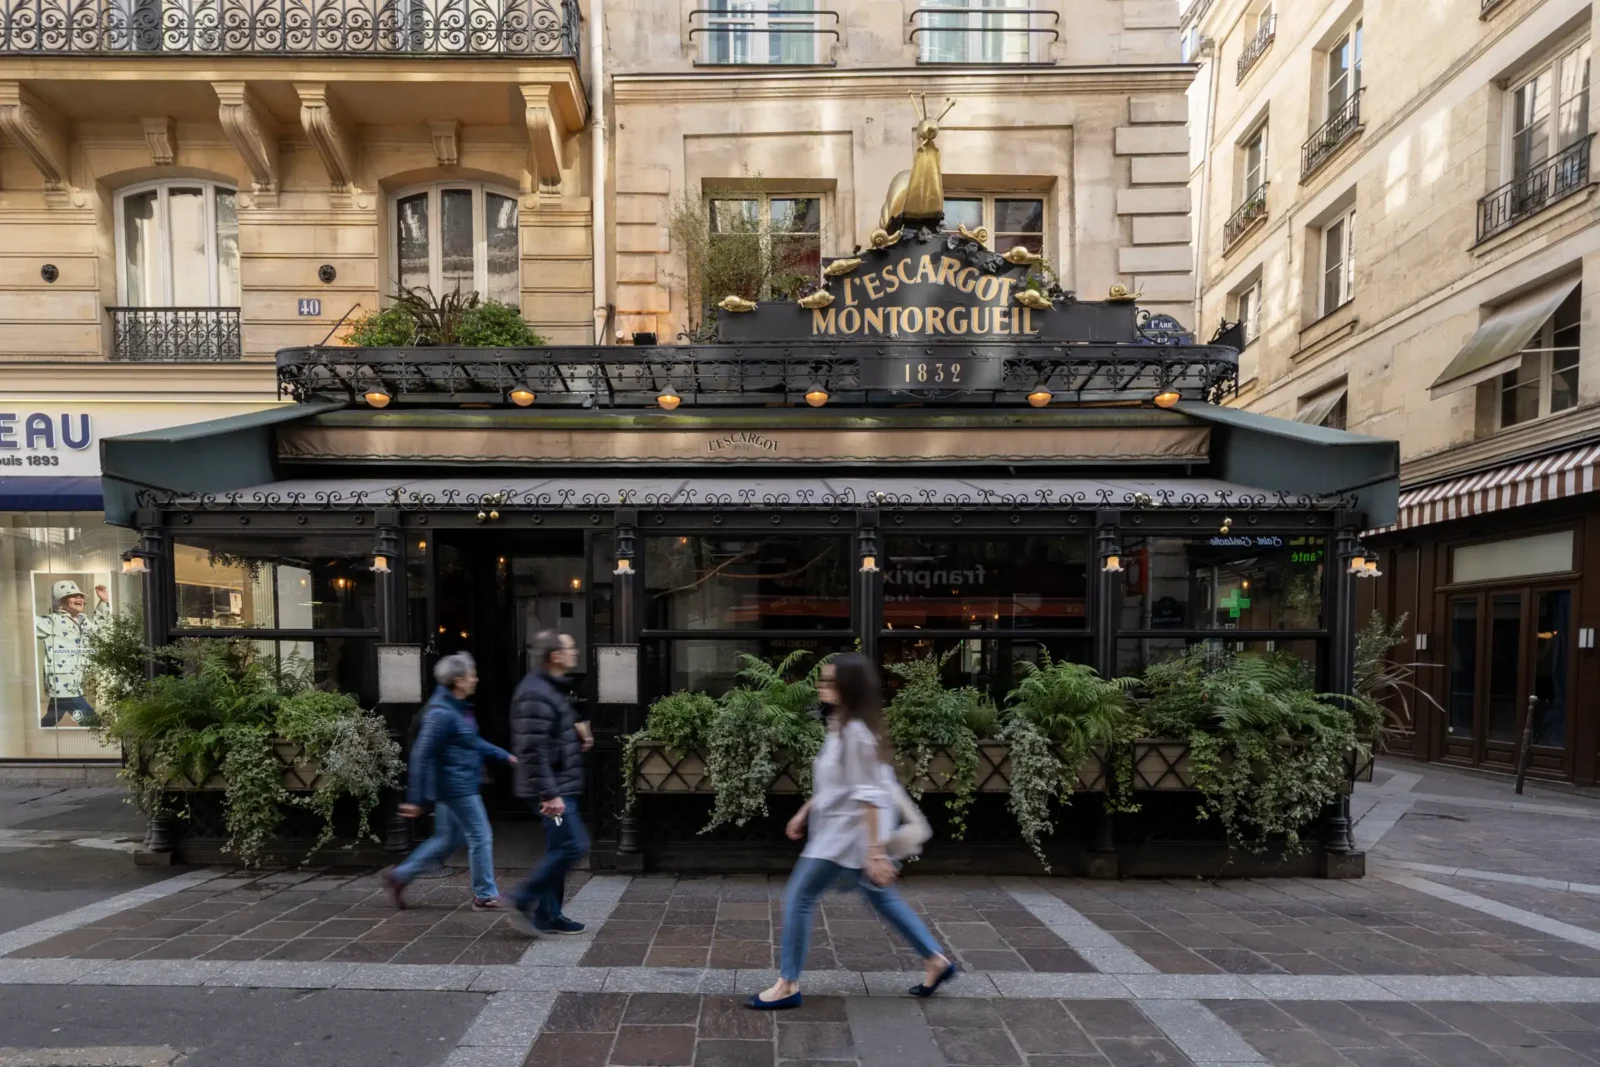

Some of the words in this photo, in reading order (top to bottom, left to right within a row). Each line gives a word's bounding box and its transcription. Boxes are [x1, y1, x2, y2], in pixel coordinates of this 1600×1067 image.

[843, 254, 1016, 307] L'ESCARGOT
[300, 299, 320, 315] 40
[812, 306, 1040, 335] MONTORGUEIL
[904, 363, 961, 383] 1832
[708, 431, 779, 452] L'ESCARGOT
[26, 455, 60, 467] 1893
